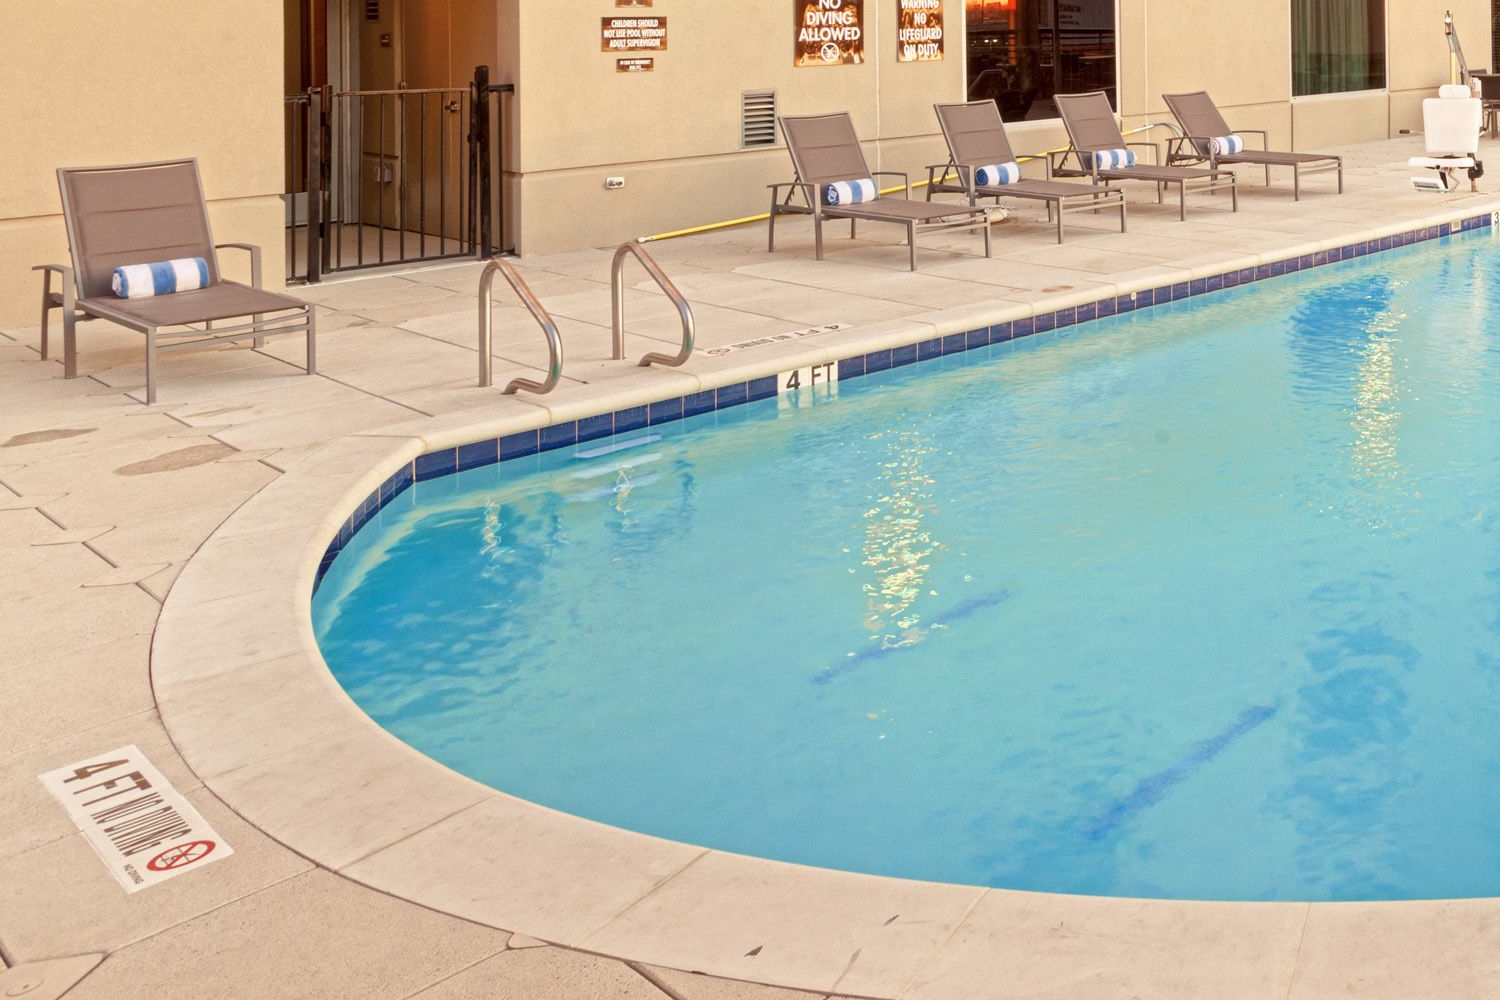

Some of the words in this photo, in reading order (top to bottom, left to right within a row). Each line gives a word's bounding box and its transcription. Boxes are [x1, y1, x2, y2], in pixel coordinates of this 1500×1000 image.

[638, 19, 658, 27] SHOULD
[806, 11, 853, 25] DIVING
[914, 12, 927, 25] NO
[604, 29, 615, 37] NOT
[616, 29, 625, 37] USE
[627, 29, 641, 37] POOL
[642, 29, 665, 37] WITHOUT
[798, 26, 861, 42] ALLOWED
[899, 27, 942, 41] LIFEGUARD
[609, 39, 625, 47] ADULT
[627, 39, 660, 47] SUPERVISION
[903, 43, 917, 57] ON
[917, 43, 939, 57] DUTY
[1495, 212, 1499, 223] 3
[786, 370, 801, 390] 4
[811, 361, 835, 386] FT
[63, 758, 130, 783] 4
[73, 770, 153, 807] FT
[91, 791, 165, 825] NO
[103, 805, 193, 857] DIVING
